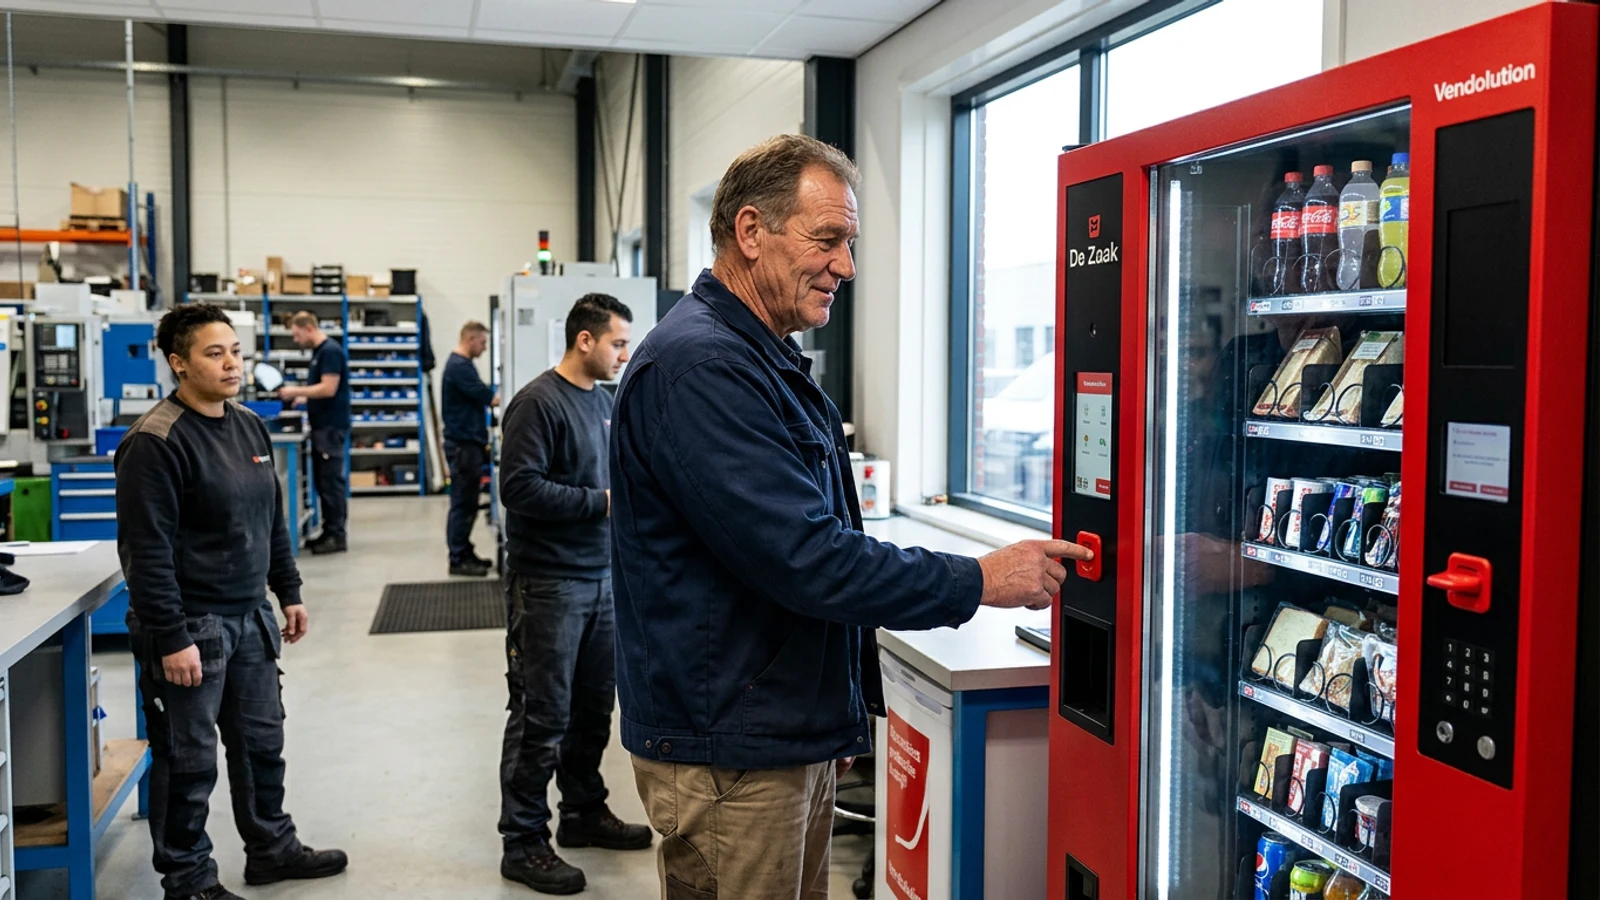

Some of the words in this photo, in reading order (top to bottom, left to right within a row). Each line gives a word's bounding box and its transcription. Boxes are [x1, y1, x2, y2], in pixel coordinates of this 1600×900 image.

[1434, 62, 1535, 102] Vendolution
[1069, 248, 1085, 268] De
[1465, 648, 1471, 658] 2
[1446, 660, 1453, 668] 4
[1464, 665, 1470, 675] 5
[1446, 676, 1452, 685] 7
